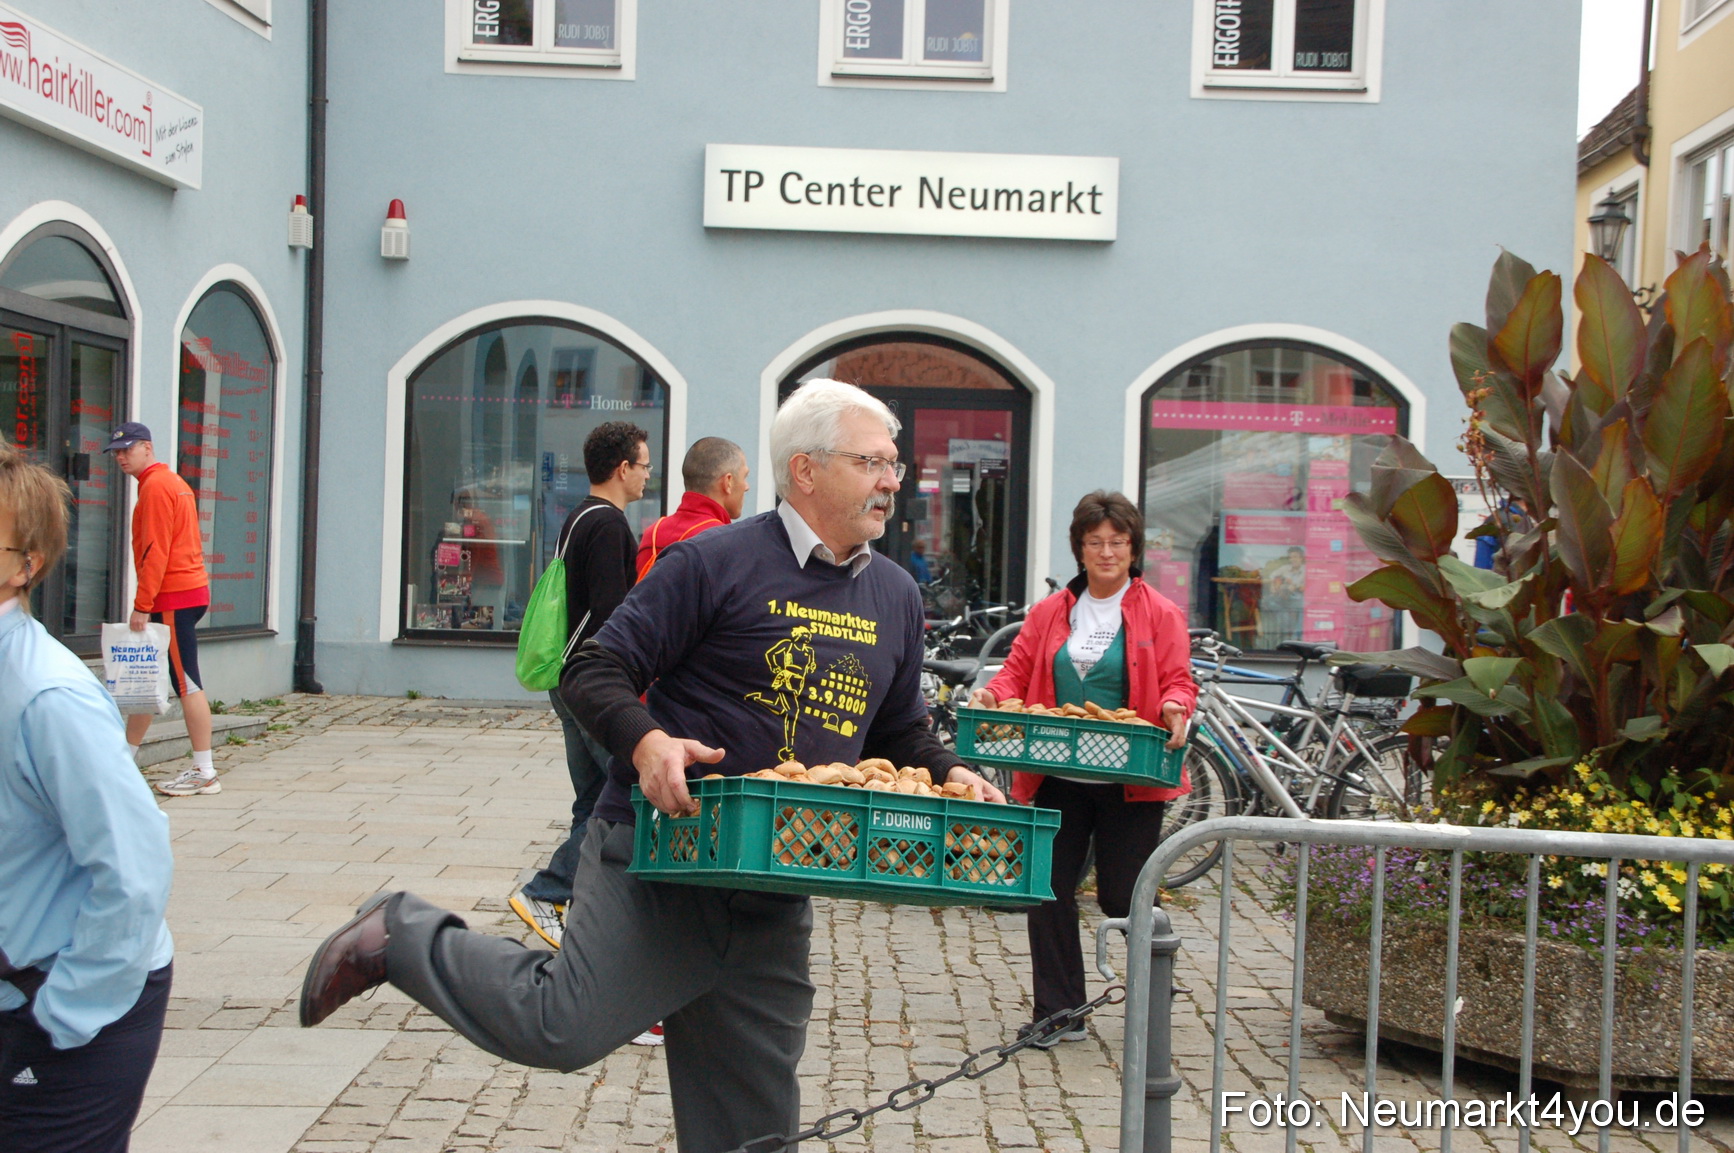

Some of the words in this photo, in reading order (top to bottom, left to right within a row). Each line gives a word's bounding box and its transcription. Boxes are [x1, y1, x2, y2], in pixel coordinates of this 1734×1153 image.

[558, 23, 581, 39] RUDI
[584, 24, 611, 41] JOBST
[1295, 52, 1318, 67] RUDI
[1321, 52, 1348, 68] JOBST
[168, 121, 178, 138] der
[720, 169, 764, 202] TP
[779, 170, 902, 207] Center
[918, 176, 1103, 215] Neumarkt
[590, 394, 633, 411] Home
[555, 453, 569, 491] Home
[767, 599, 783, 615] 1.
[785, 601, 878, 633] Neumarkter
[810, 621, 878, 647] STADTLAUF
[808, 686, 867, 716] 3.9.2000
